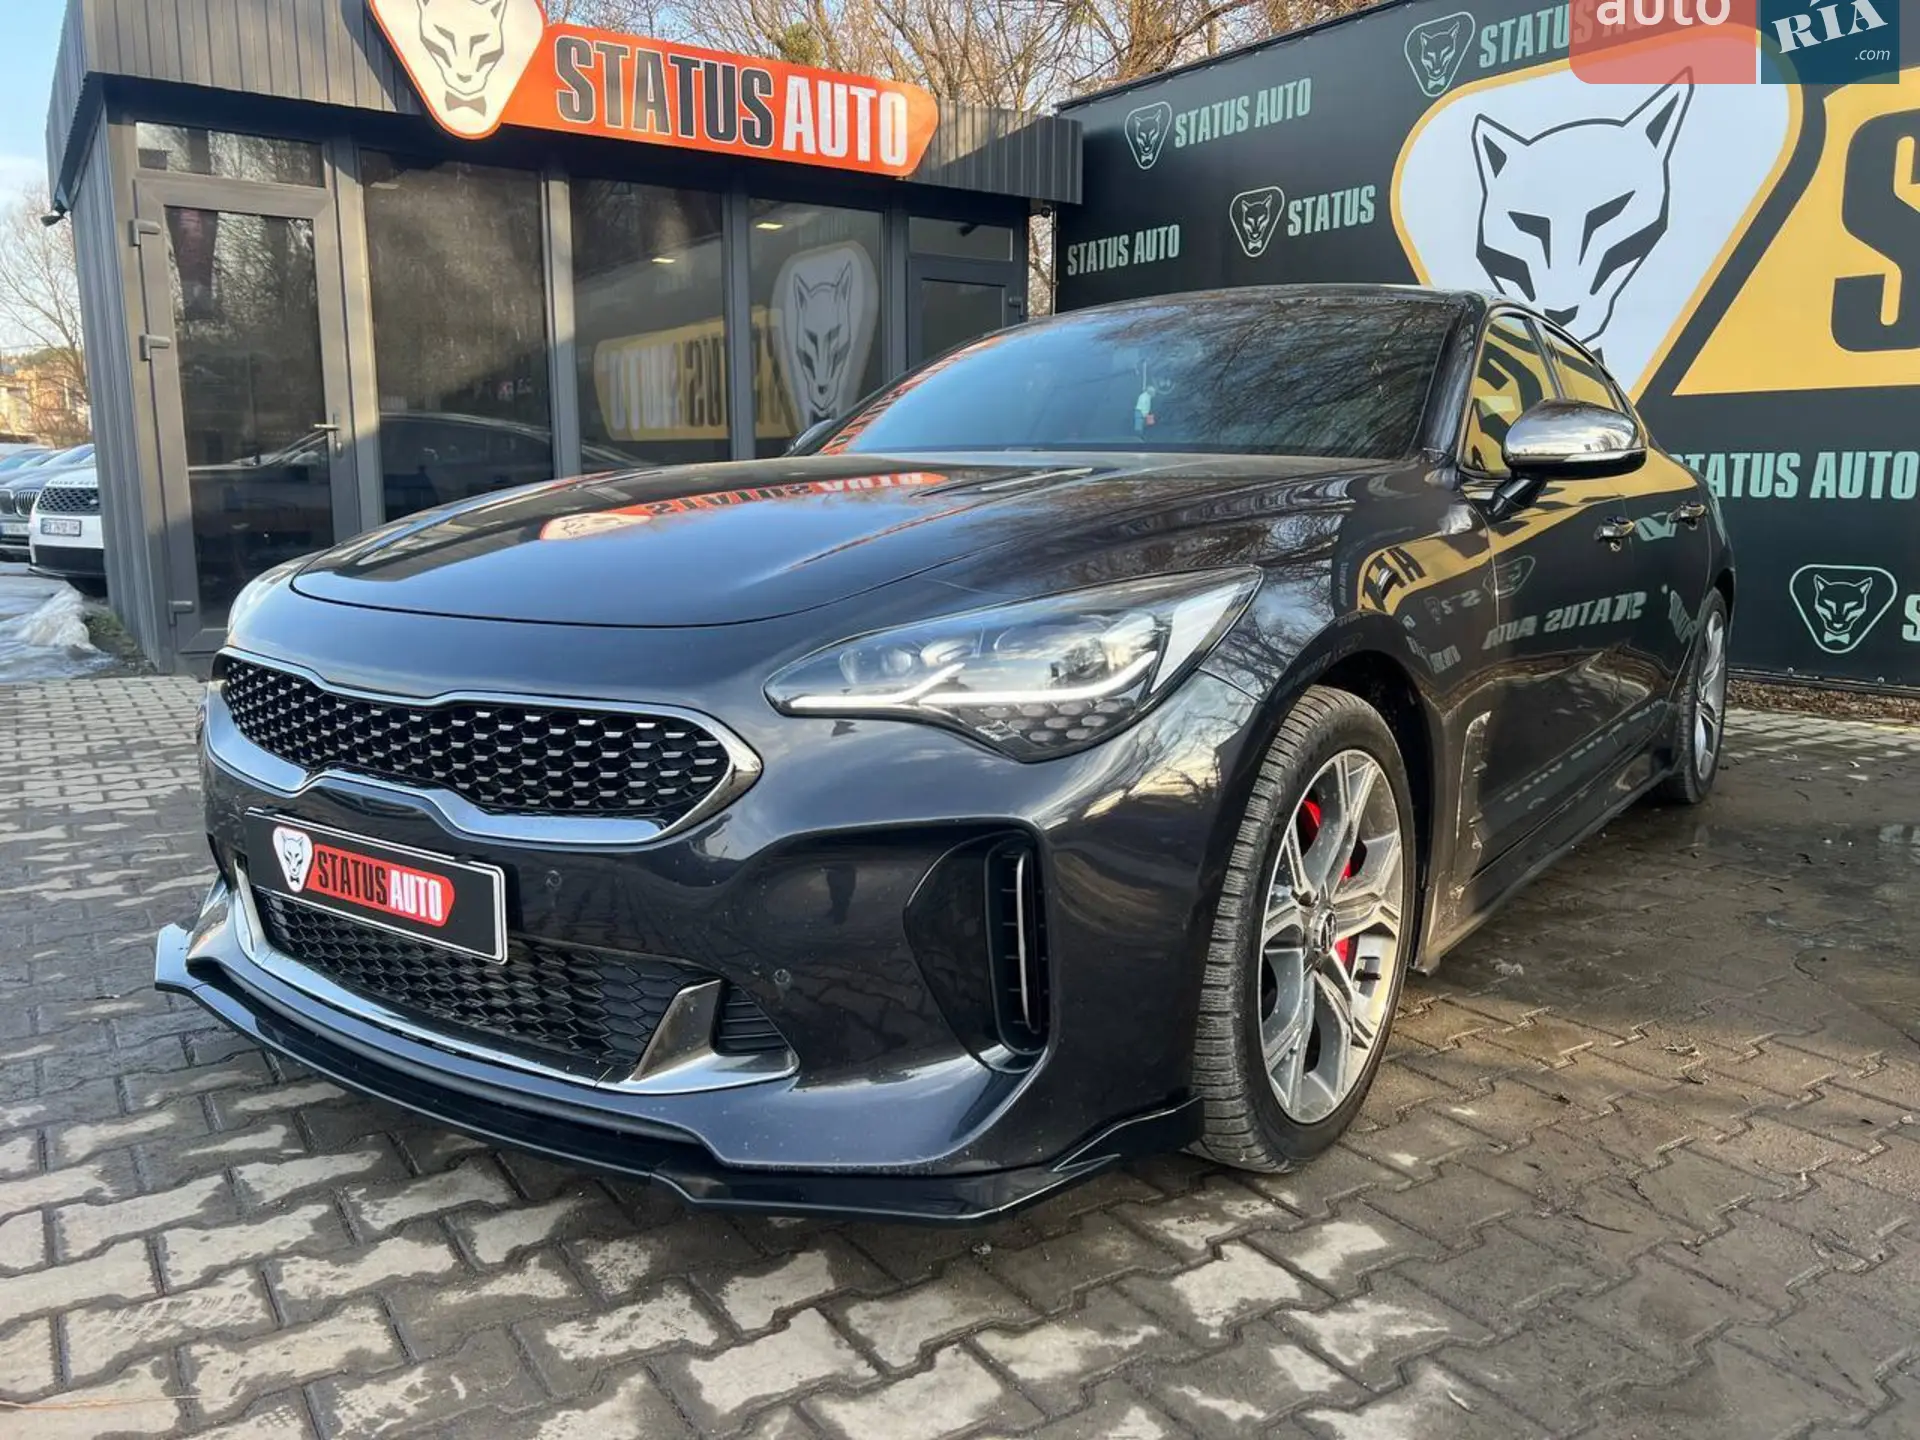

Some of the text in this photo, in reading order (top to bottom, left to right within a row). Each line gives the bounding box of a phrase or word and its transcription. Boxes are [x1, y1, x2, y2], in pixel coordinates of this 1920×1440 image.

[553, 36, 910, 166] STATUS AUTO
[1174, 77, 1313, 149] STATUS AUTO
[1287, 184, 1377, 237] STATUS
[1066, 224, 1181, 276] STATUS AUTO
[1669, 451, 1920, 500] TATUS AUTO
[317, 850, 442, 922] STATUS AUTO
